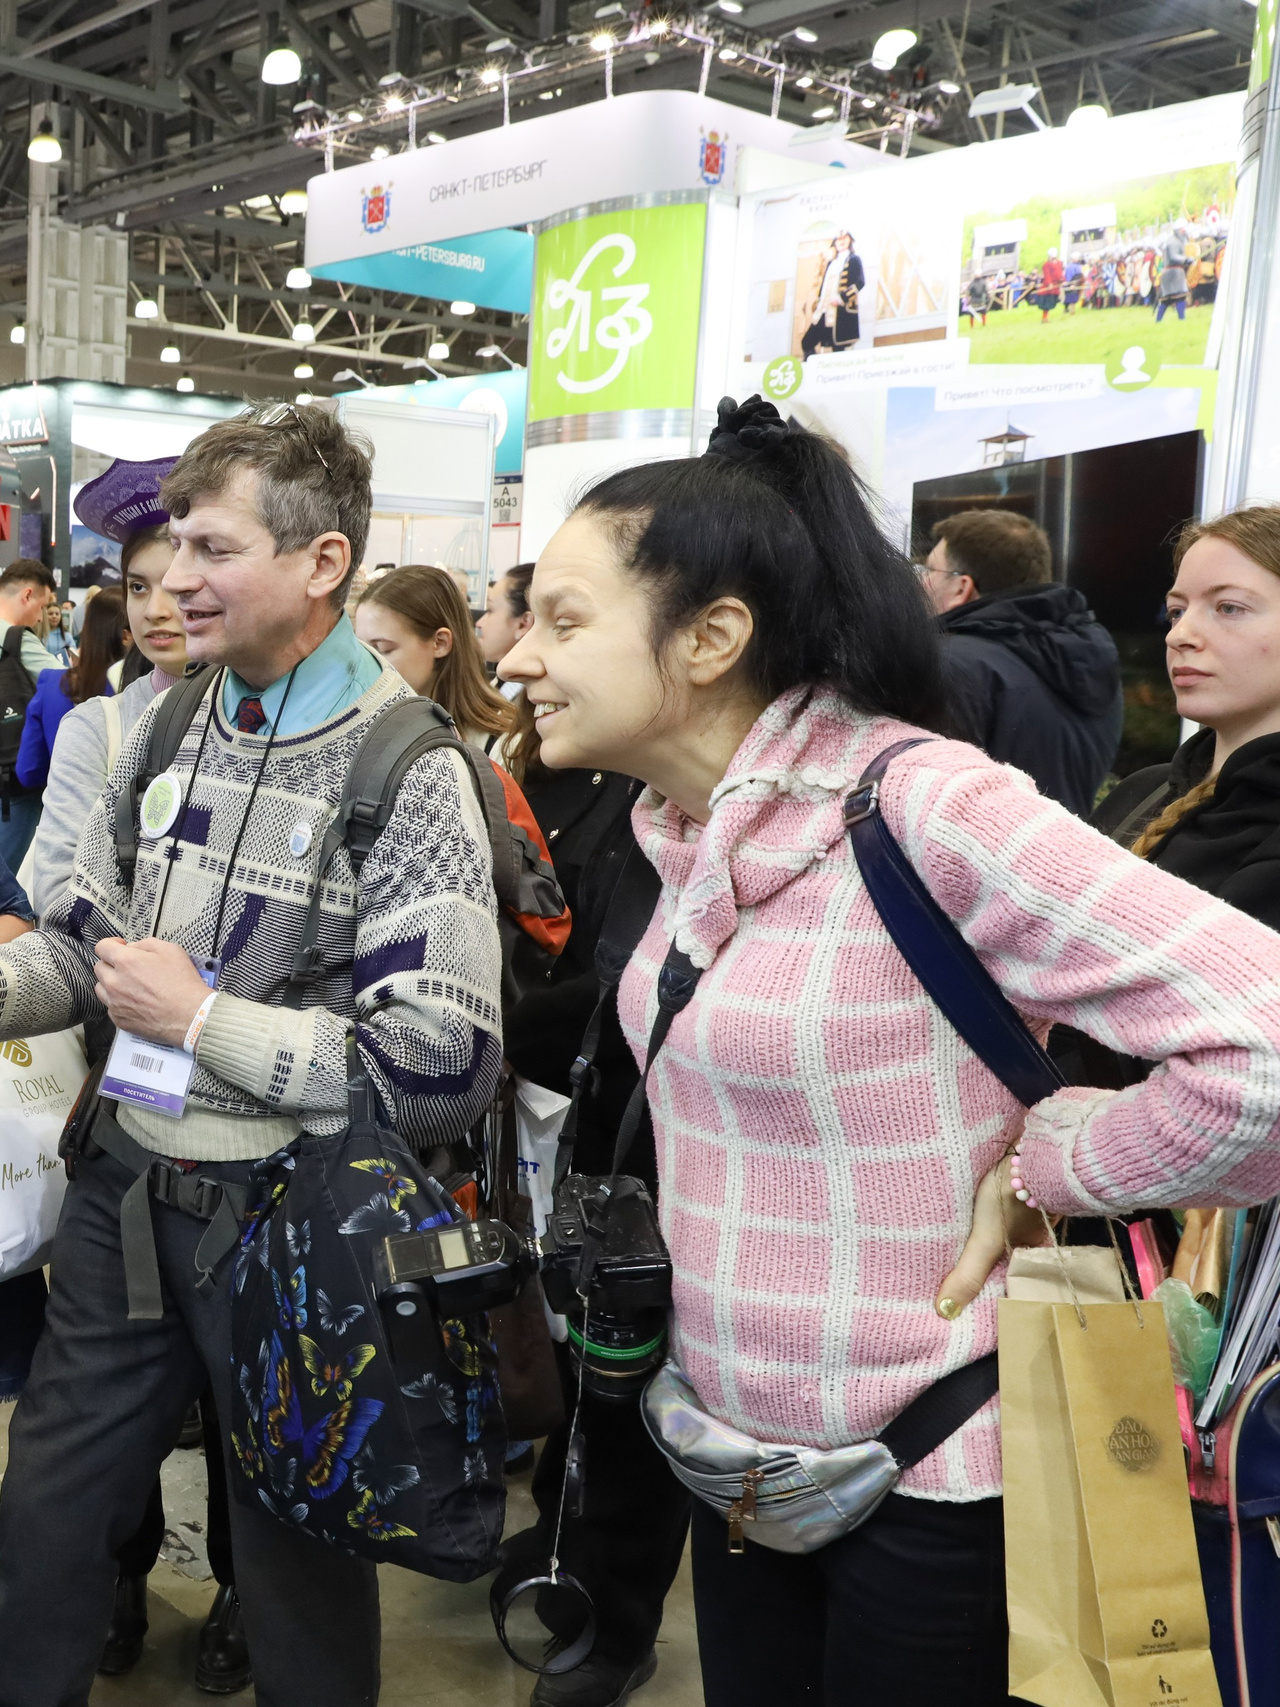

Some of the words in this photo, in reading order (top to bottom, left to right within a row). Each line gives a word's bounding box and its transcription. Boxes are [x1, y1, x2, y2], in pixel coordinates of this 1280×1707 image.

[429, 159, 548, 203] САНКТ-ПЕТЕРБУРГ
[944, 387, 989, 402] Привет!
[991, 385, 1012, 397] Что
[1015, 378, 1094, 396] посмотреть?
[493, 497, 518, 509] 5043
[12, 1074, 65, 1104] ROYAL
[22, 1103, 47, 1118] GROUP
[49, 1096, 72, 1110] HOTELS
[1, 1162, 33, 1191] More
[36, 1152, 61, 1178] than
